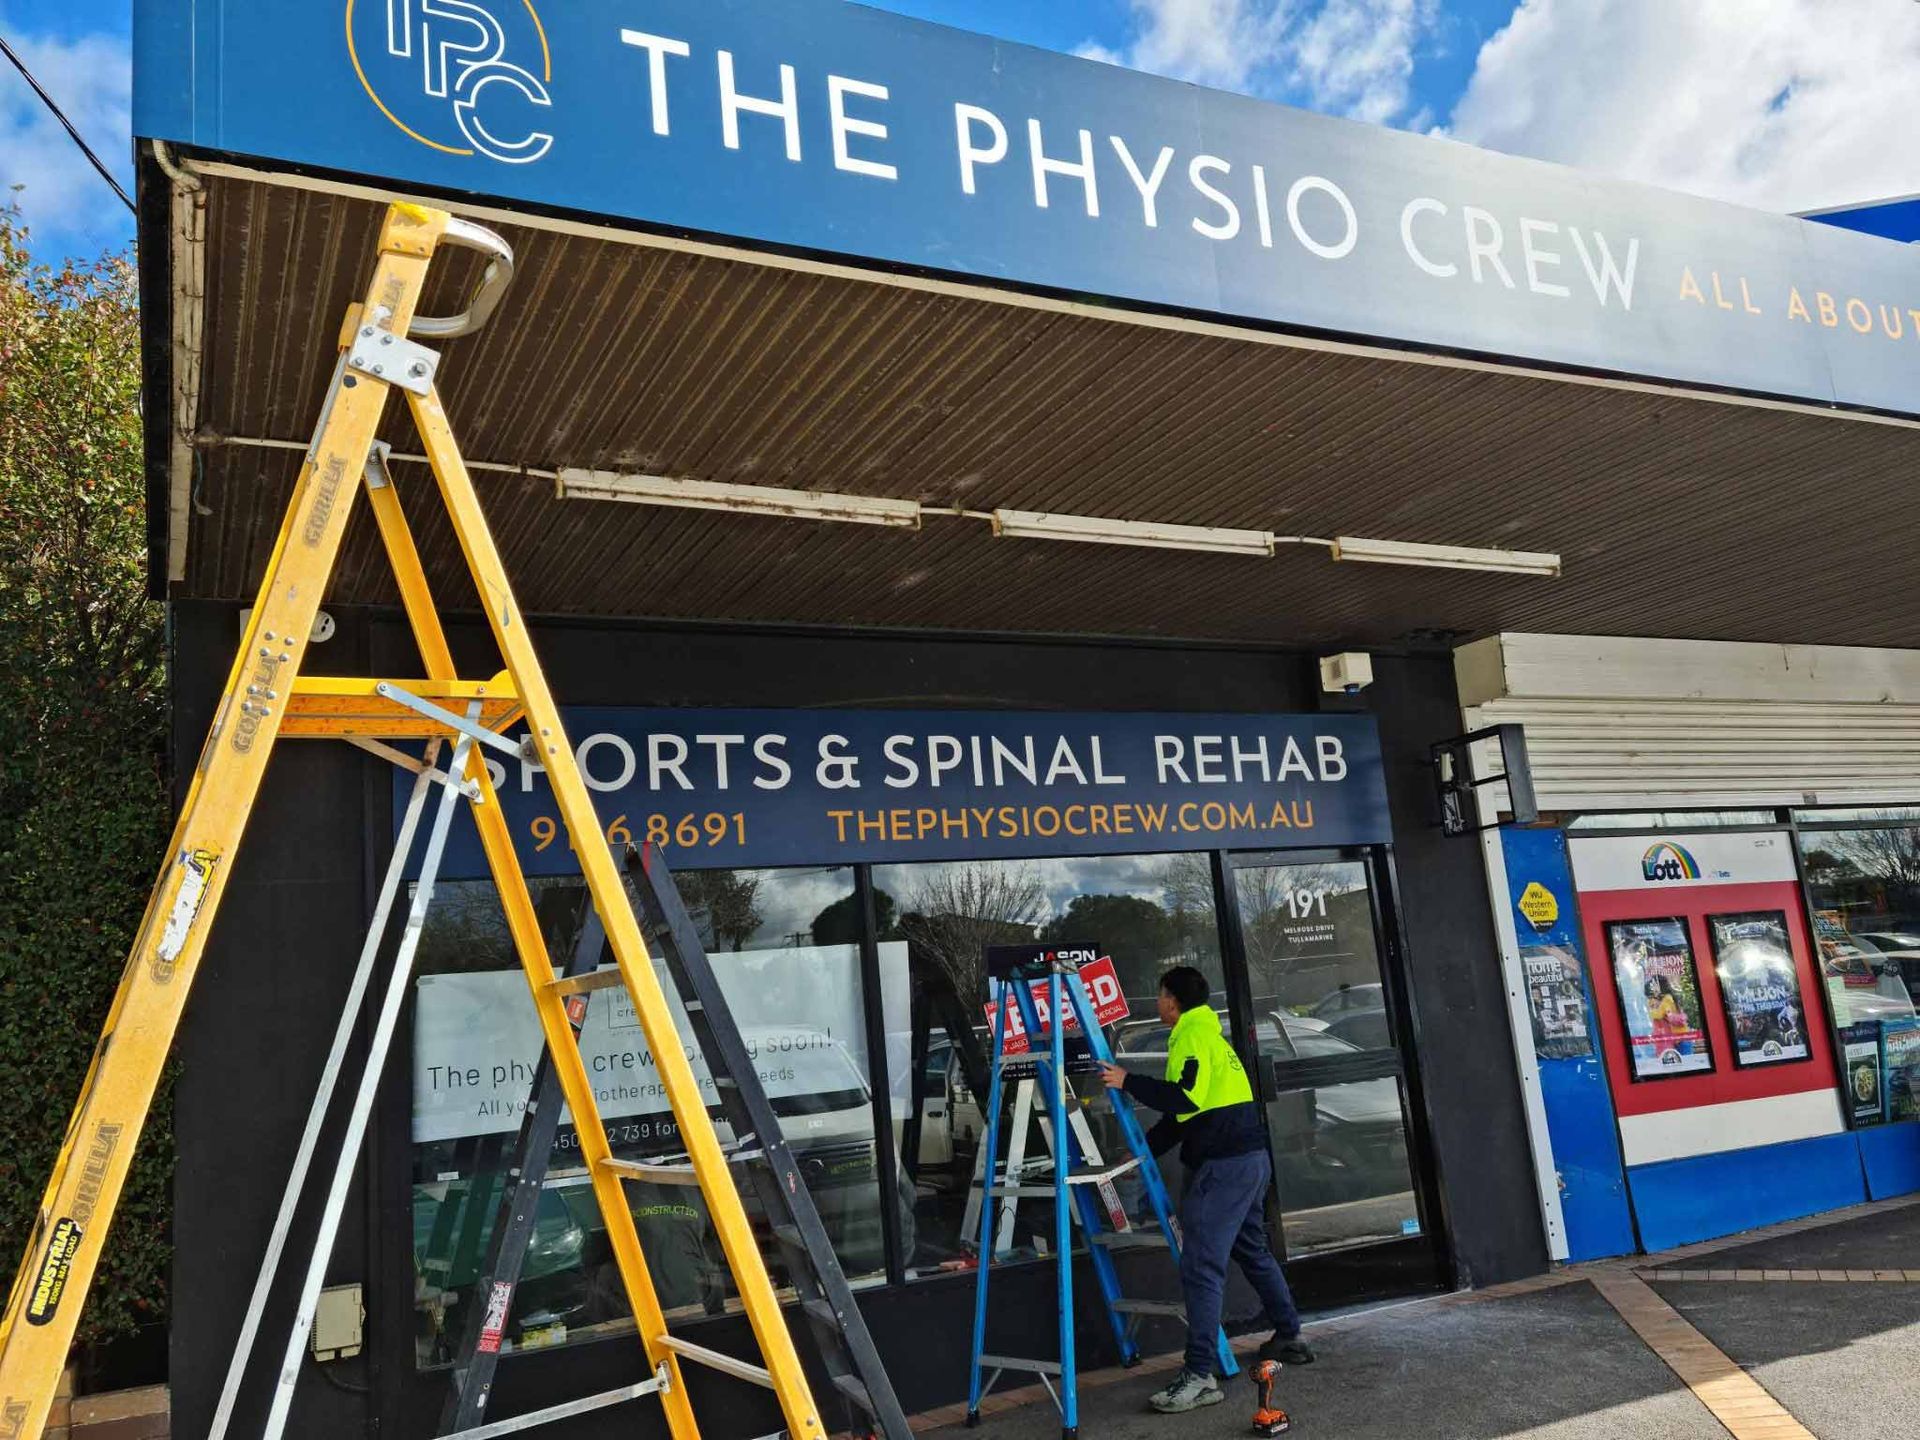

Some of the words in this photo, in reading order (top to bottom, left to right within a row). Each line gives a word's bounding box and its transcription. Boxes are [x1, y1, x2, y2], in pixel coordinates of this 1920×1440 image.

[620, 29, 898, 180] THE
[955, 102, 1358, 259] PHYSIO
[1400, 197, 1640, 311] CREW
[1680, 265, 1761, 314] ALL
[816, 734, 861, 788] &
[883, 735, 1126, 788] SPINAL
[1155, 735, 1348, 784] REHAB
[646, 811, 747, 848] 8691
[827, 800, 1315, 842] THEPHYSIOCREW.COM.AU
[1283, 888, 1327, 918] 191
[1522, 901, 1553, 910] Western
[1529, 909, 1549, 917] Union
[1283, 925, 1314, 934] MELROSE
[1315, 924, 1335, 932] DRIVE
[1288, 933, 1335, 943] TULLAMARINE
[1034, 950, 1096, 963] JASON
[427, 1066, 480, 1090] The
[492, 1059, 538, 1088] phy
[592, 1049, 655, 1073] crew
[766, 1027, 832, 1053] soon!
[477, 1101, 500, 1117] All
[507, 1098, 526, 1117] yo
[594, 1083, 667, 1102] iotherap
[760, 1067, 795, 1083] eeds
[622, 1123, 650, 1141] 739
[71, 1123, 122, 1226] ORILLA
[31, 1222, 73, 1315] INDUSTRIAL
[50, 1281, 64, 1304] 150KG
[66, 1235, 77, 1257] LOAD
